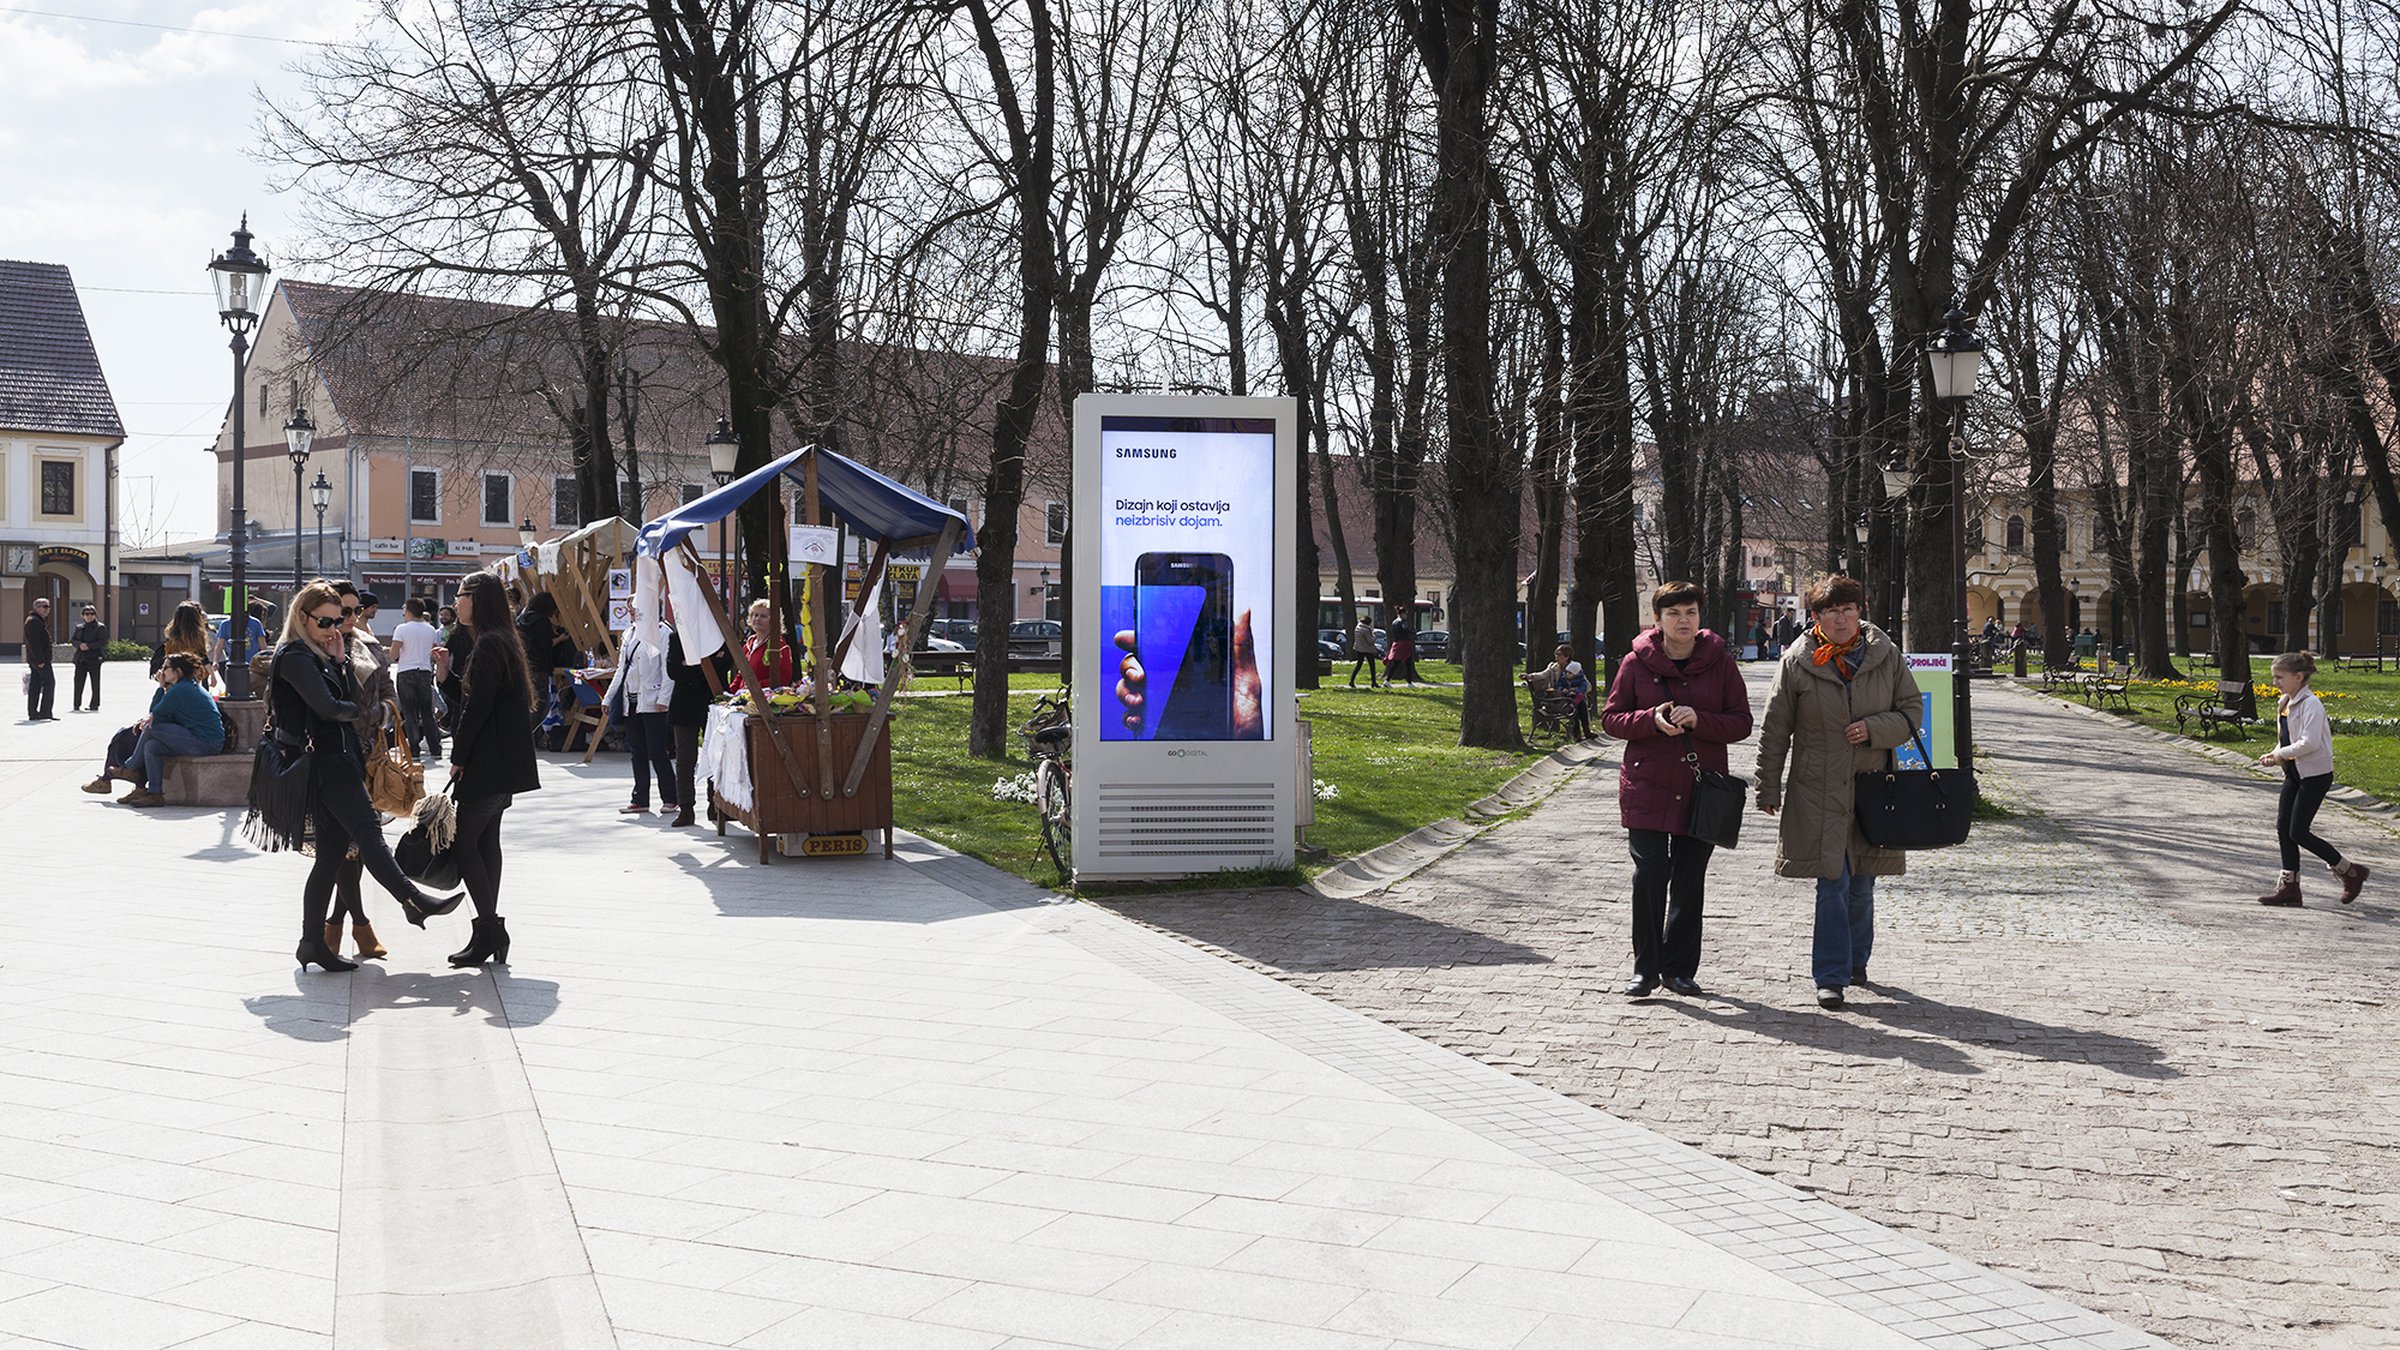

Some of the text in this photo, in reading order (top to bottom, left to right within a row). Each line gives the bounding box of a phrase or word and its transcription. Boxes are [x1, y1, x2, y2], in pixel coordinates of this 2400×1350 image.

[1116, 448, 1177, 459] SAMSUNG
[1116, 499, 1230, 515] Dizajn koji ostavlja
[1116, 515, 1223, 529] neizbrisiv dojam.
[1911, 656, 1947, 667] PROLJEĆE
[809, 839, 863, 852] PERIS
